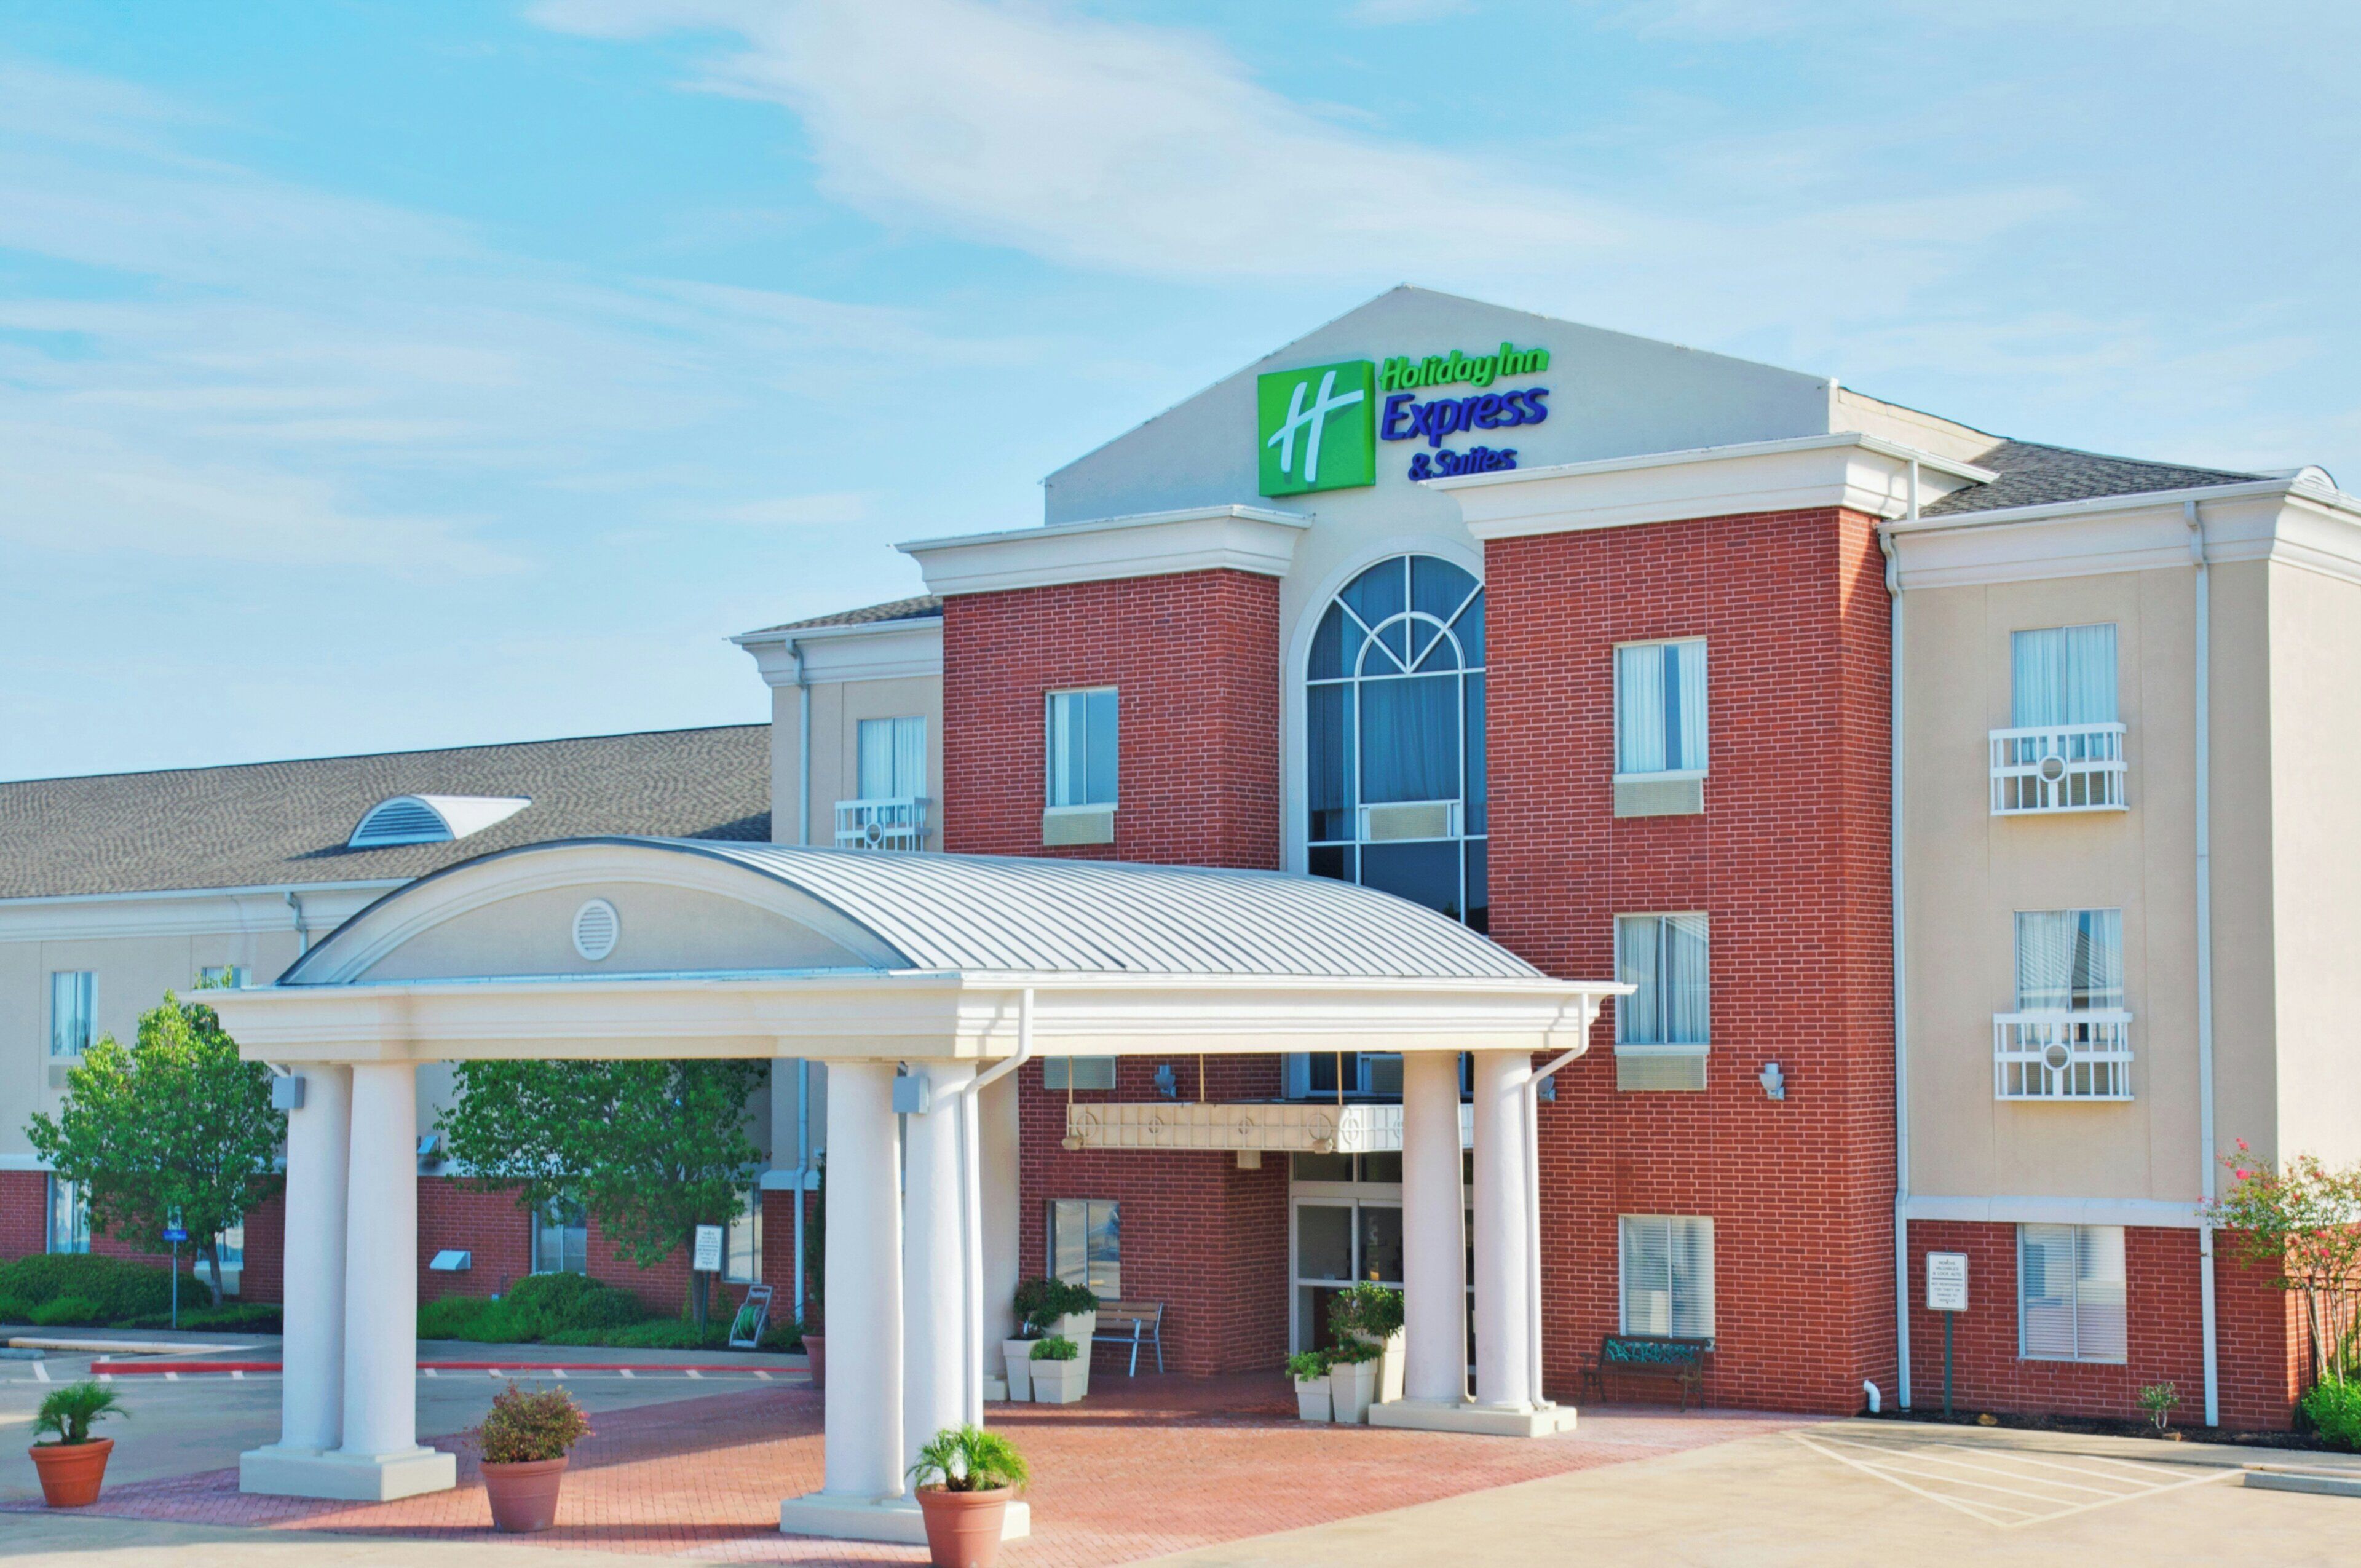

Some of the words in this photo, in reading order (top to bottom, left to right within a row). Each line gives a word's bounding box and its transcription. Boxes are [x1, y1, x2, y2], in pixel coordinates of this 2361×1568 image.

[1378, 349, 1498, 391] Holiday
[1497, 341, 1550, 376] Inn
[1380, 387, 1550, 448] Express
[1408, 453, 1433, 481] &
[1432, 446, 1517, 478] Suites
